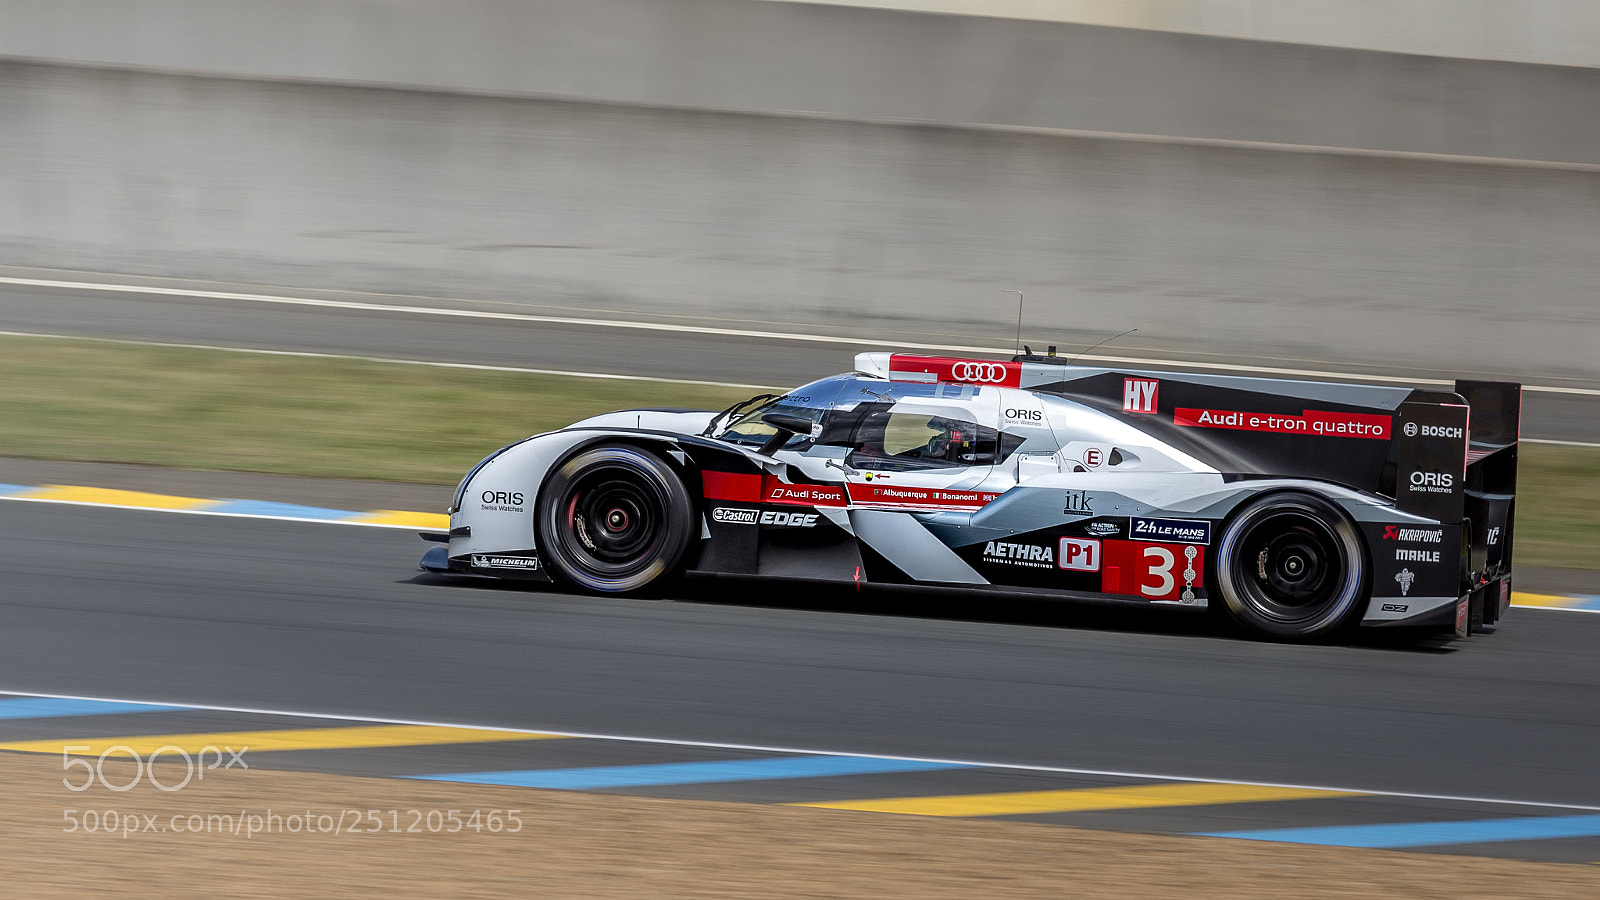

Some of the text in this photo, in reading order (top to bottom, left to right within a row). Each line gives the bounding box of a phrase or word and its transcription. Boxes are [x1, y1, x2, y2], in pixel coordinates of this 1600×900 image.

[1124, 380, 1157, 412] HY
[1005, 408, 1042, 421] ORIS
[1198, 410, 1383, 435] Audi e-tron quattro
[1421, 425, 1462, 439] BOSCH
[1410, 471, 1453, 487] ORIS
[785, 489, 841, 500] Audi Sport
[882, 488, 978, 501] Albuquerque Bonanomi
[1409, 484, 1452, 494] Swiss Watches
[482, 490, 524, 505] ORIS
[1064, 490, 1094, 510] itk
[499, 505, 524, 513] Watches
[723, 510, 819, 528] Castrol EDGE
[1135, 520, 1205, 537] 24h LE MANS
[1398, 528, 1443, 543] AKRAPOVIČ
[983, 541, 1053, 562] AETHRA
[1066, 542, 1093, 566] P1
[1395, 549, 1440, 562] MAHLE
[490, 557, 535, 566] MICHELIN
[1141, 546, 1175, 596] 3
